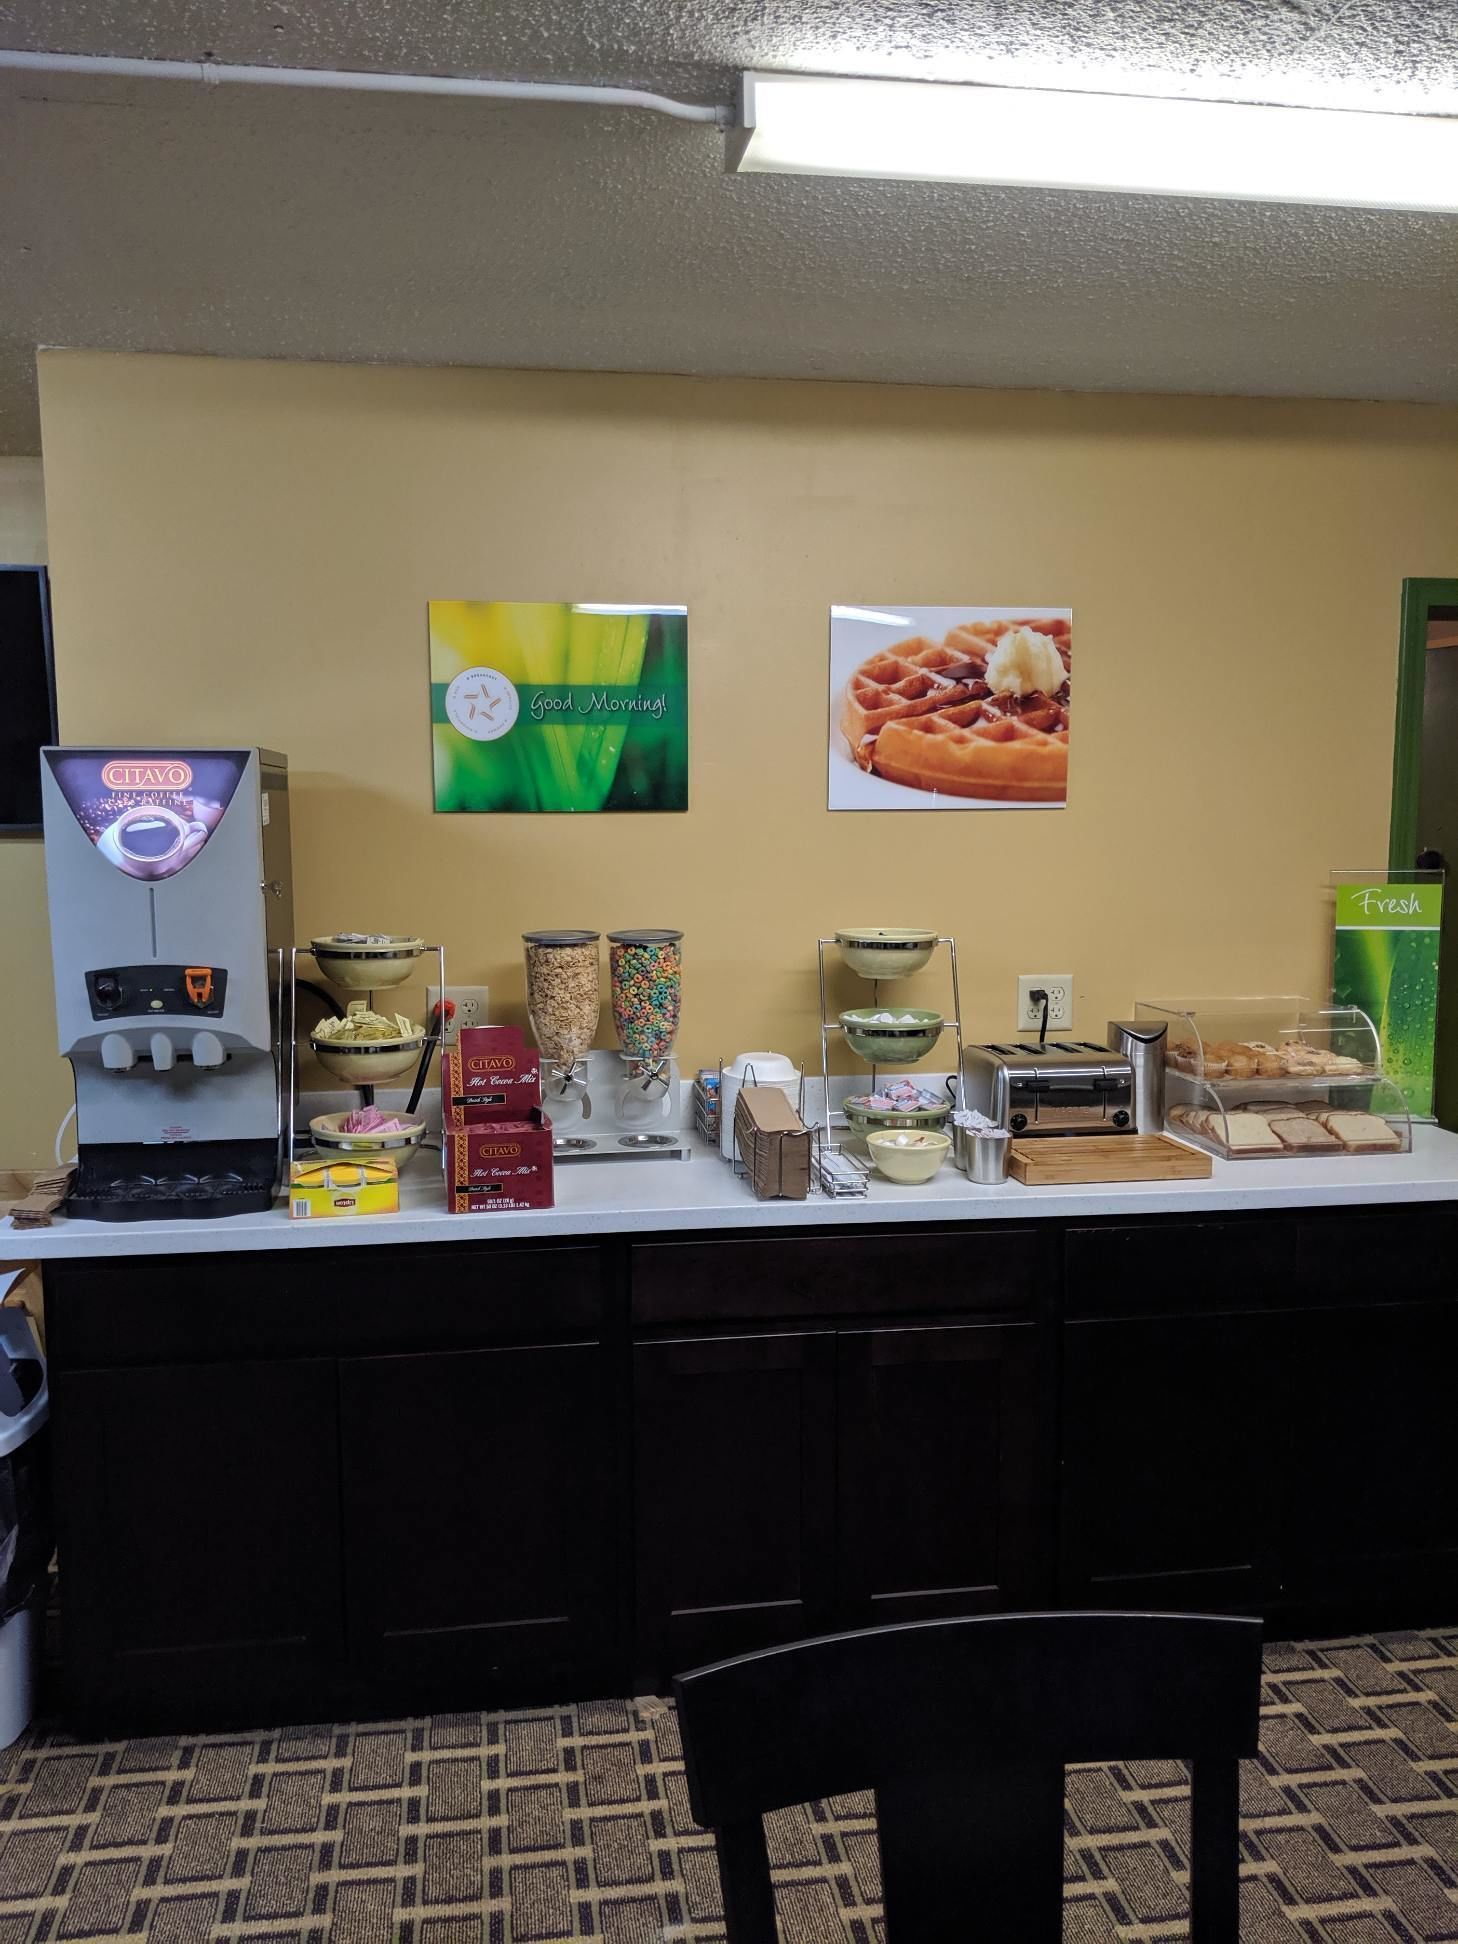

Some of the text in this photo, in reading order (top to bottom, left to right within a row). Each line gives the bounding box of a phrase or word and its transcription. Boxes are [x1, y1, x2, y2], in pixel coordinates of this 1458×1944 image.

[530, 690, 574, 720] Good
[578, 691, 667, 719] Morning!
[108, 767, 185, 785] CITAVO
[143, 791, 185, 799] COFFEE
[1350, 888, 1422, 915] Fresh
[471, 1058, 512, 1069] CITAVO
[467, 1073, 537, 1087] Hot Cocoa Mix
[482, 1146, 518, 1156] CITAVO
[470, 1166, 532, 1178] Hot Cocoa Mix
